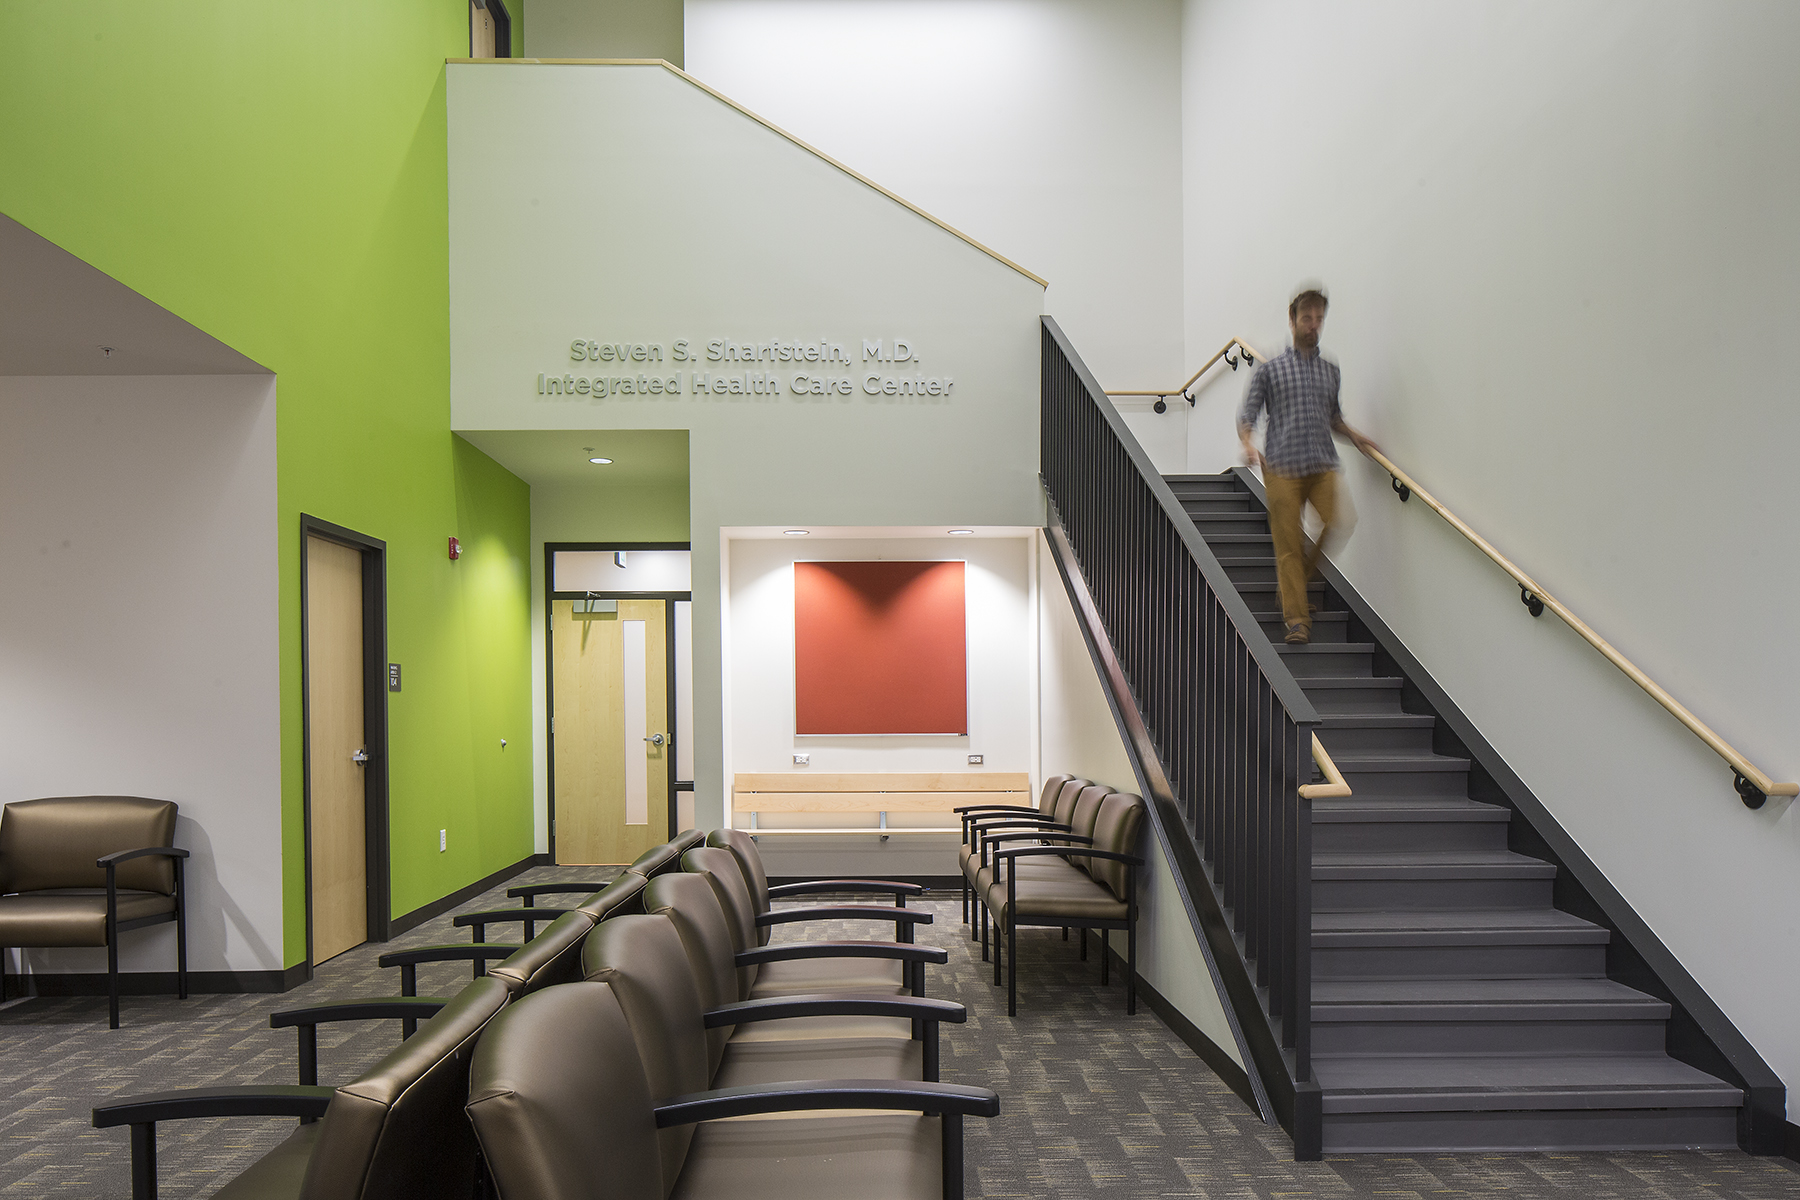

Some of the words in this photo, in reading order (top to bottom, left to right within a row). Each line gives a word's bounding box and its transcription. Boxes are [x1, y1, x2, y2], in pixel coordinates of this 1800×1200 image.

[570, 339, 664, 362] Steven
[672, 339, 698, 362] S.
[706, 338, 852, 366] Sharfstein,
[862, 339, 920, 363] M.D.
[537, 372, 682, 399] Integrated
[691, 371, 781, 396] Health
[789, 373, 853, 396] Care
[861, 373, 954, 397] Center
